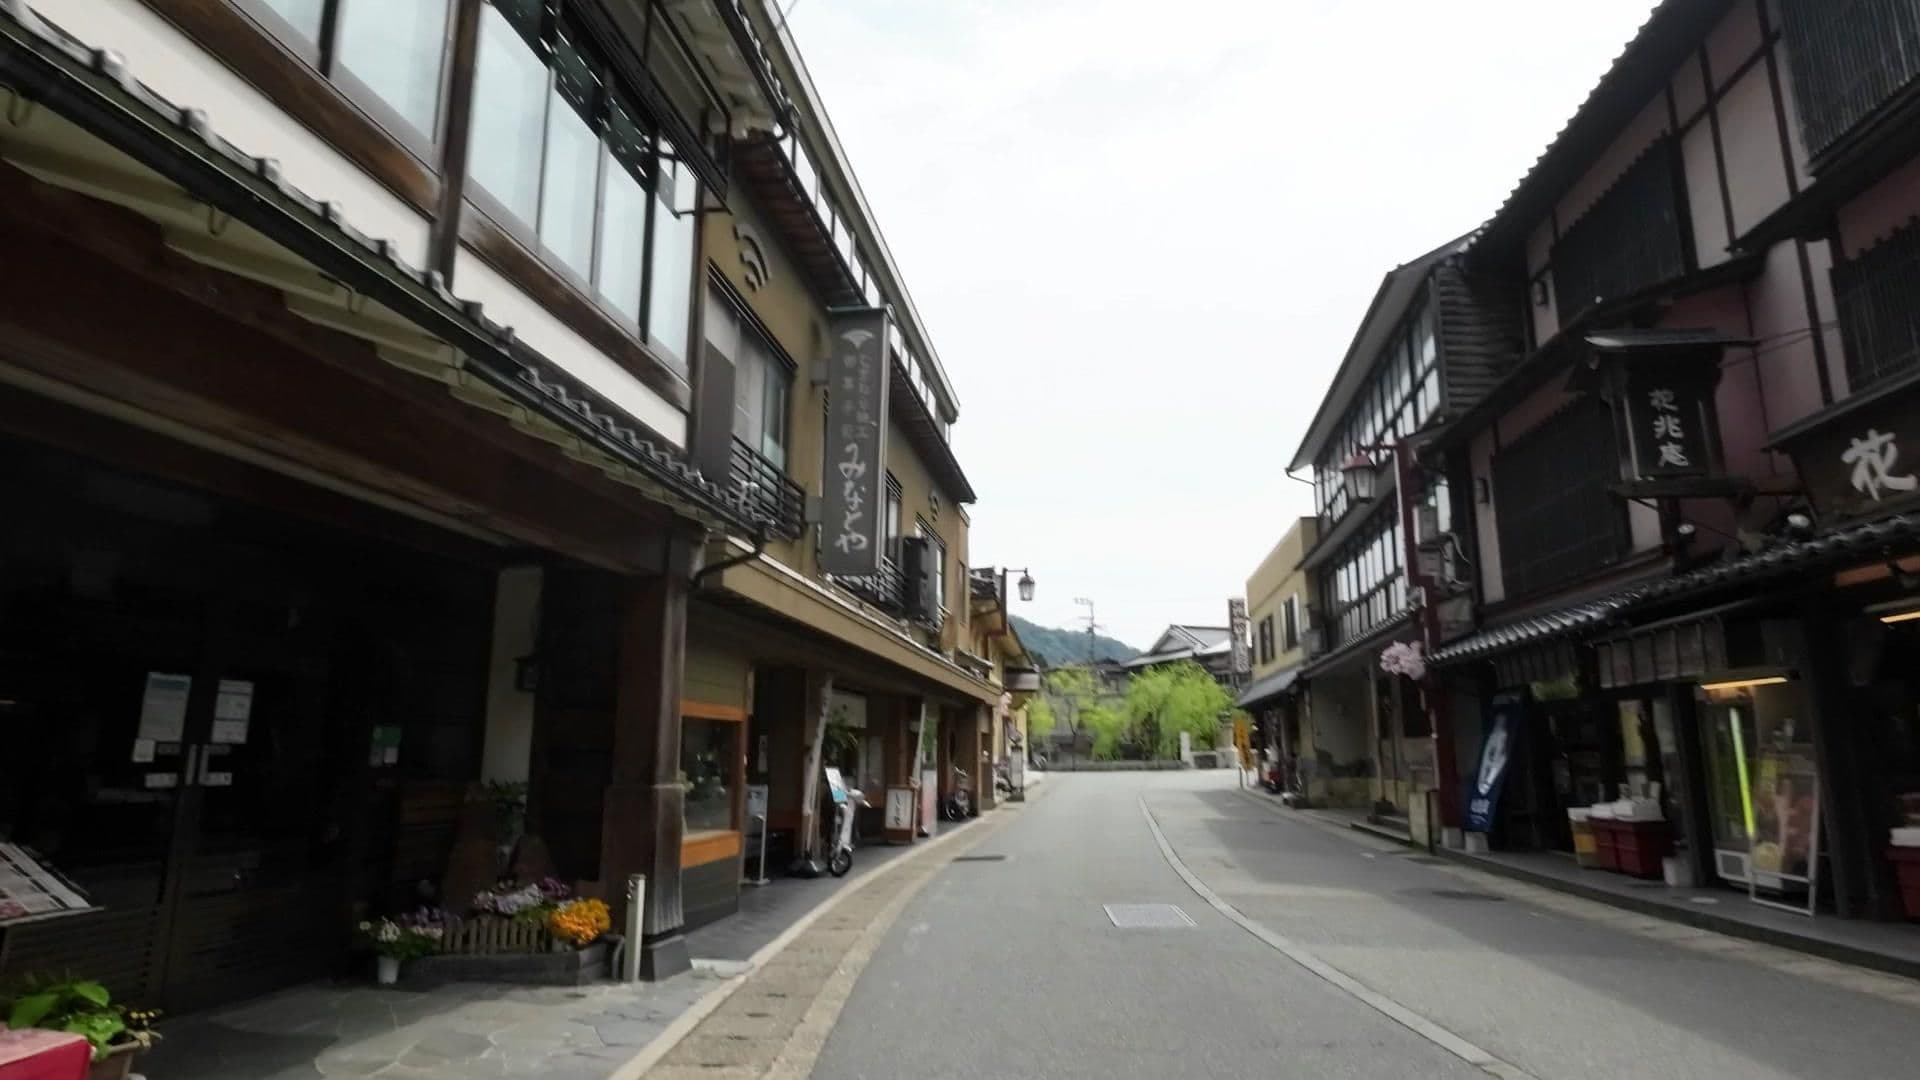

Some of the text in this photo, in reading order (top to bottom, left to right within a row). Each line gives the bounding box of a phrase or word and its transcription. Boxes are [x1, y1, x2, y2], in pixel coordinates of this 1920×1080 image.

[1648, 389, 1689, 467] 花兆庵
[1841, 429, 1918, 502] 花
[835, 443, 867, 553] みなとや
